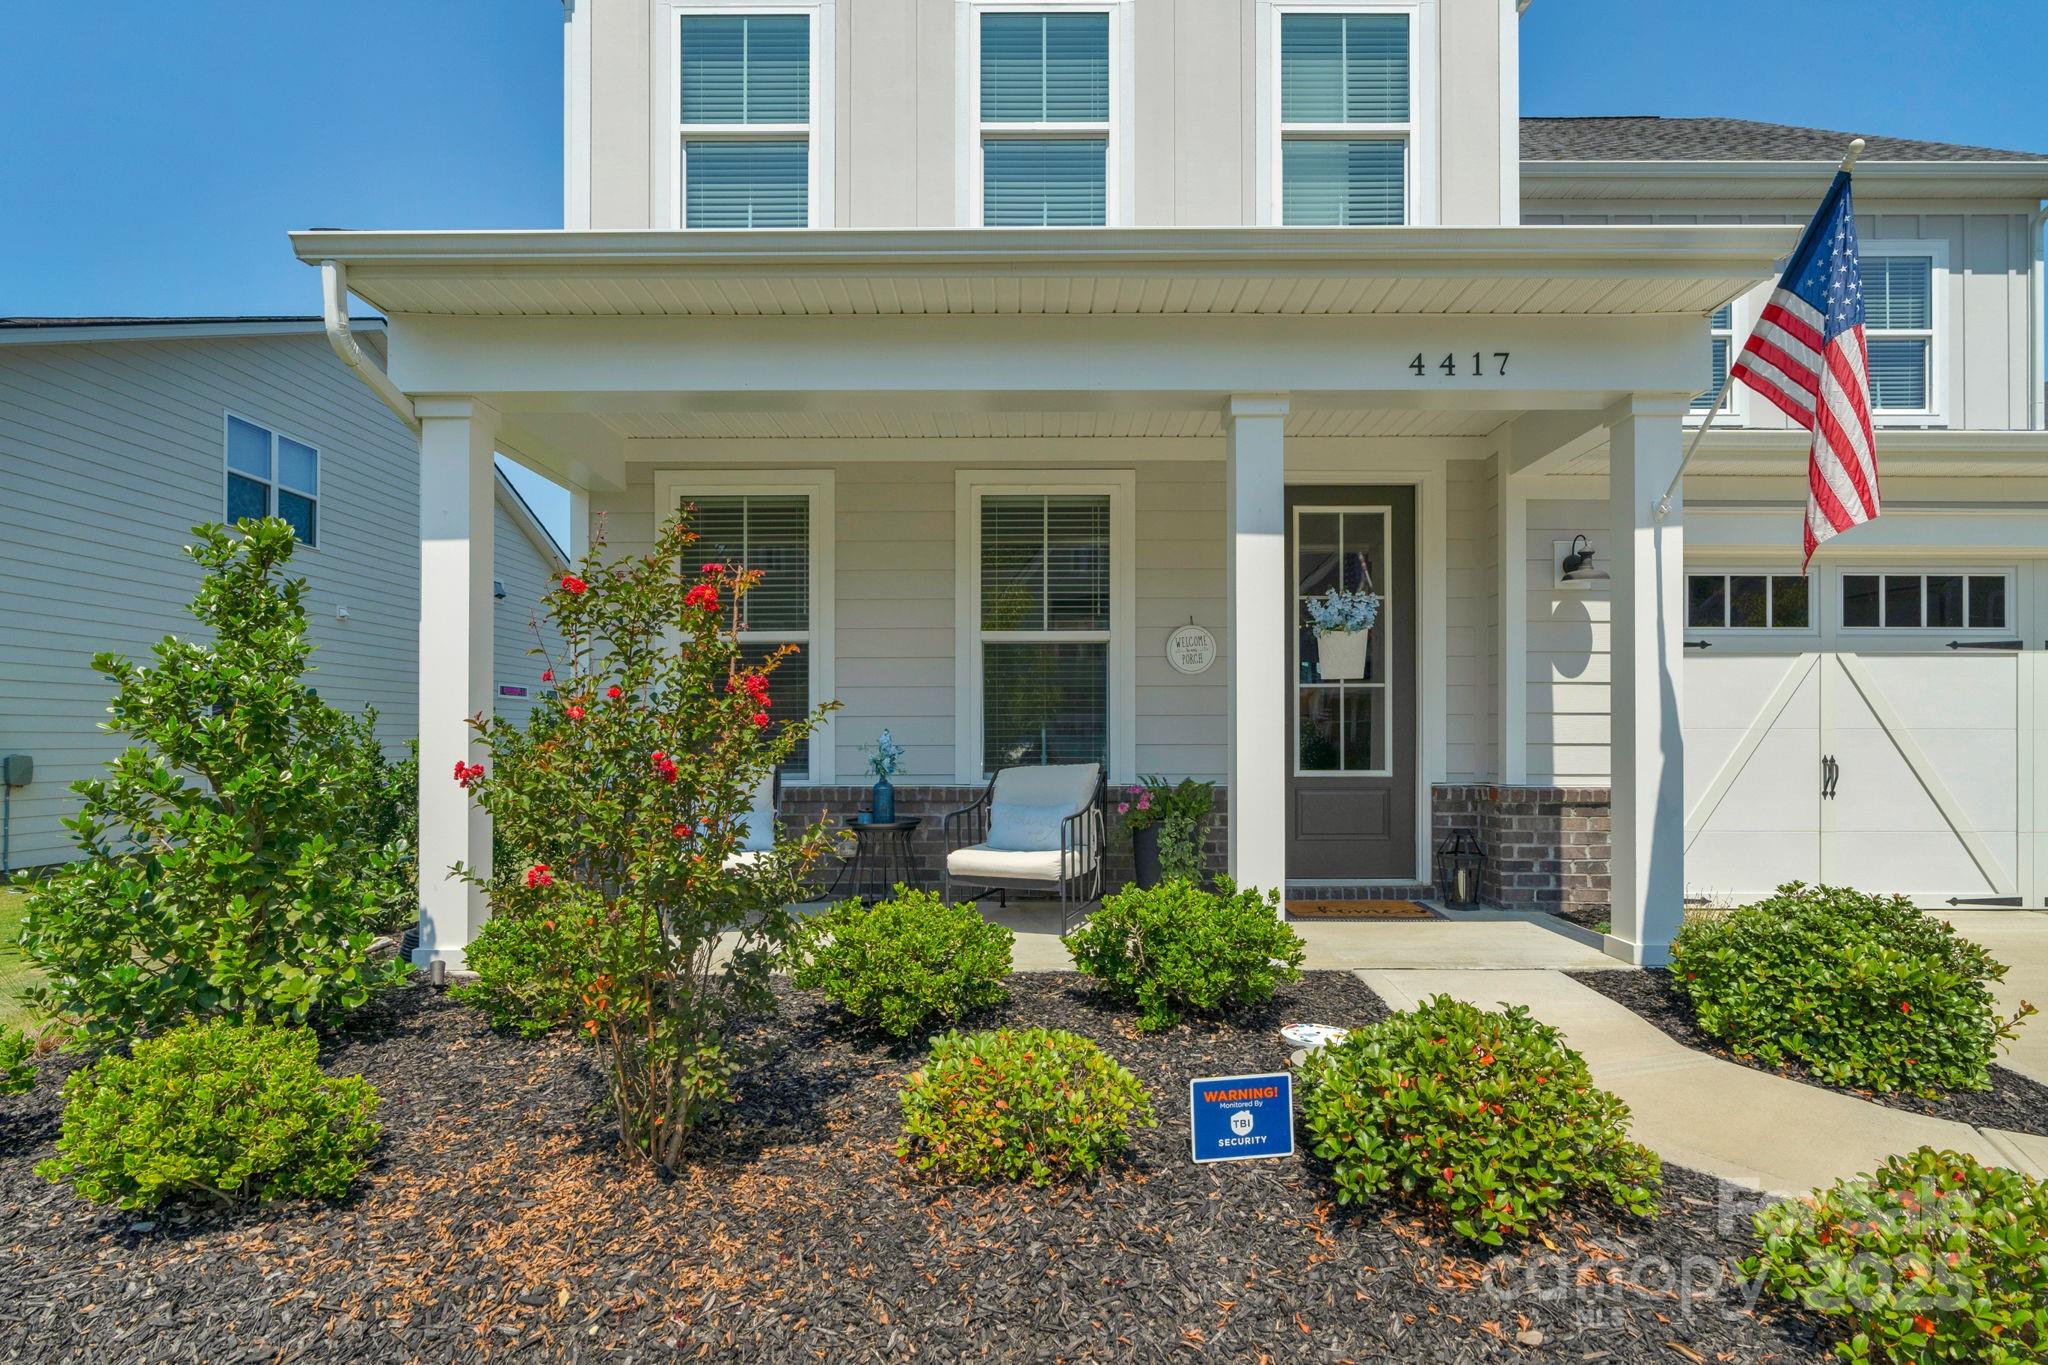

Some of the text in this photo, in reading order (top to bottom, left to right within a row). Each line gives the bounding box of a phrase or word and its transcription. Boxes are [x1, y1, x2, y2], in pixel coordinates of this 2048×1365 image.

[1408, 352, 1510, 376] 4417
[1175, 635, 1208, 648] WELCOME
[1182, 653, 1203, 665] PORCH
[1203, 1087, 1279, 1102] WARNING!
[1220, 1100, 1263, 1109] Monitored By
[1233, 1119, 1251, 1129] TBI
[1218, 1136, 1267, 1147] SECURITY
